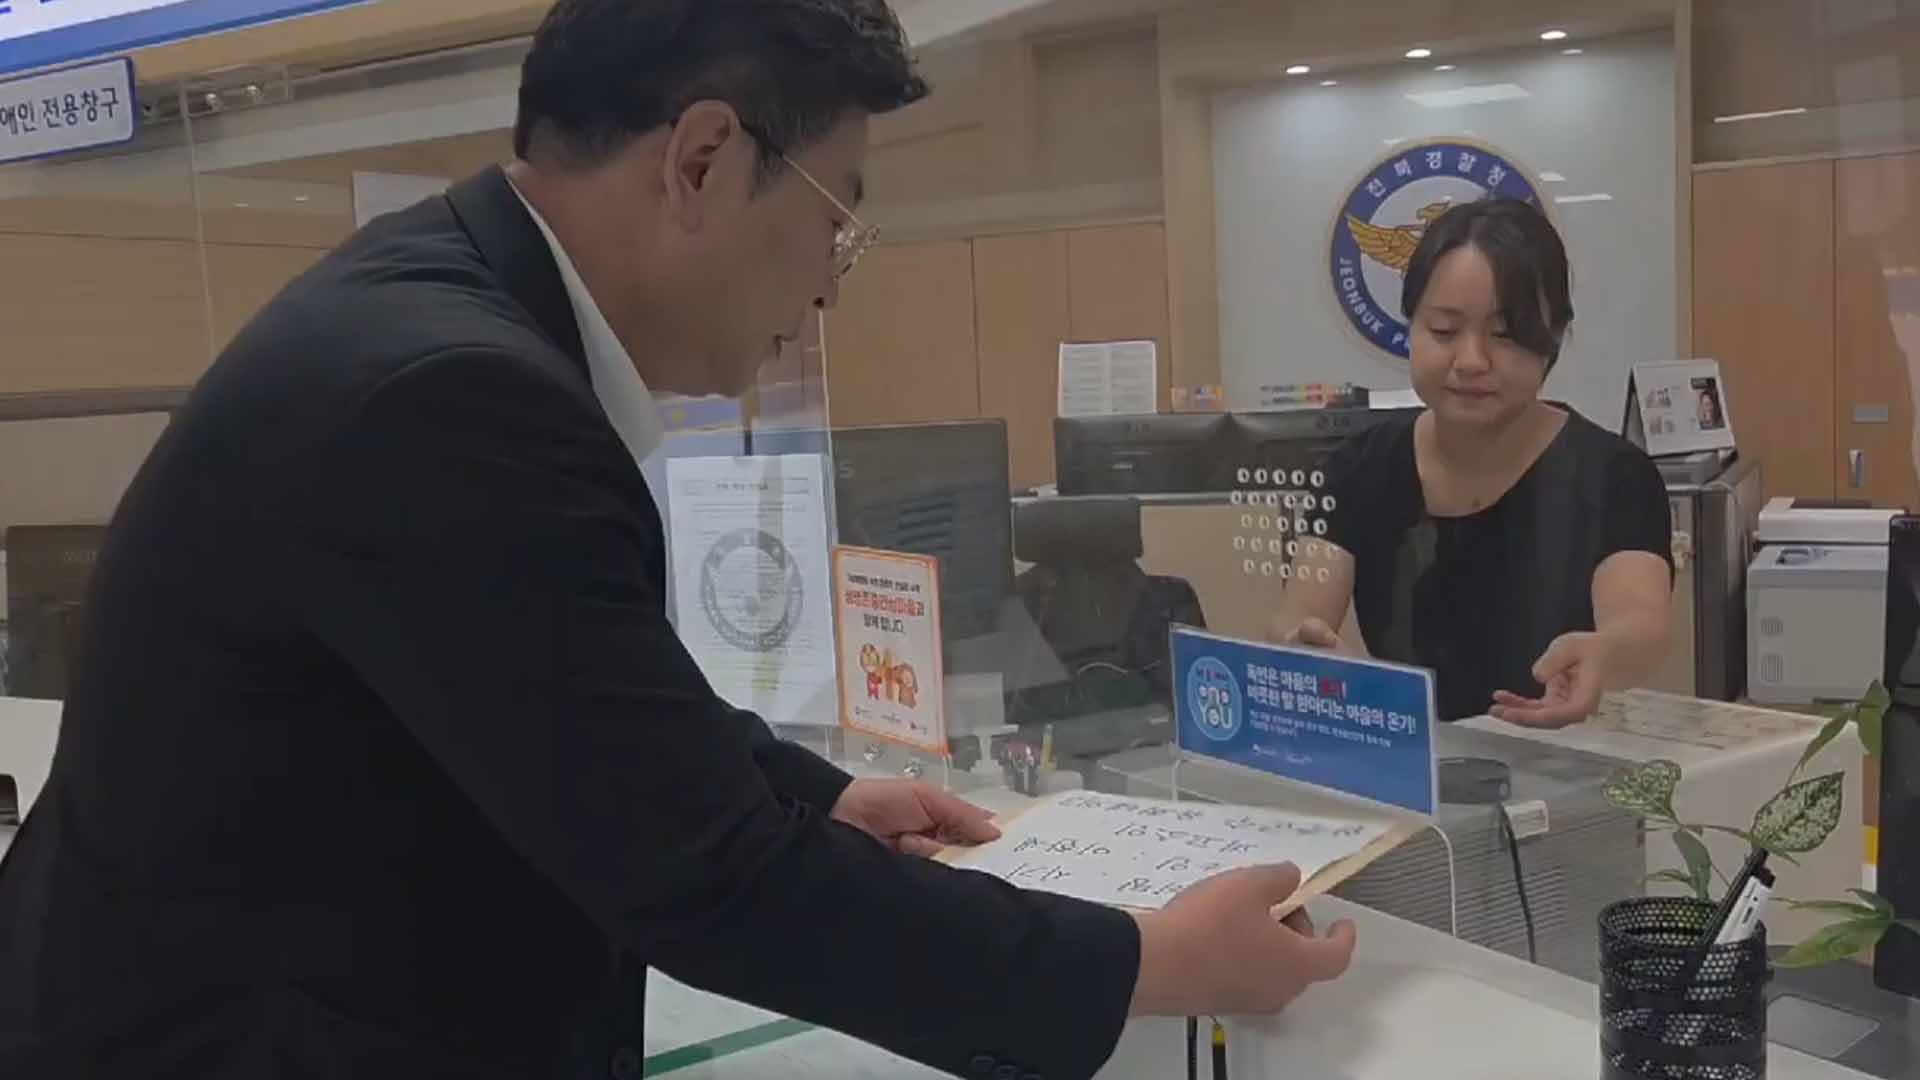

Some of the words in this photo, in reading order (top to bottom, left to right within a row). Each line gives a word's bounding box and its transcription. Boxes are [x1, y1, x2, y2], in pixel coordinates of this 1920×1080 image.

[42, 87, 119, 129] 전용창구
[1339, 257, 1386, 334] JEONBUK
[1279, 669, 1318, 695] 마음의
[1296, 692, 1346, 719] 한마디는
[1346, 704, 1385, 730] 마음의
